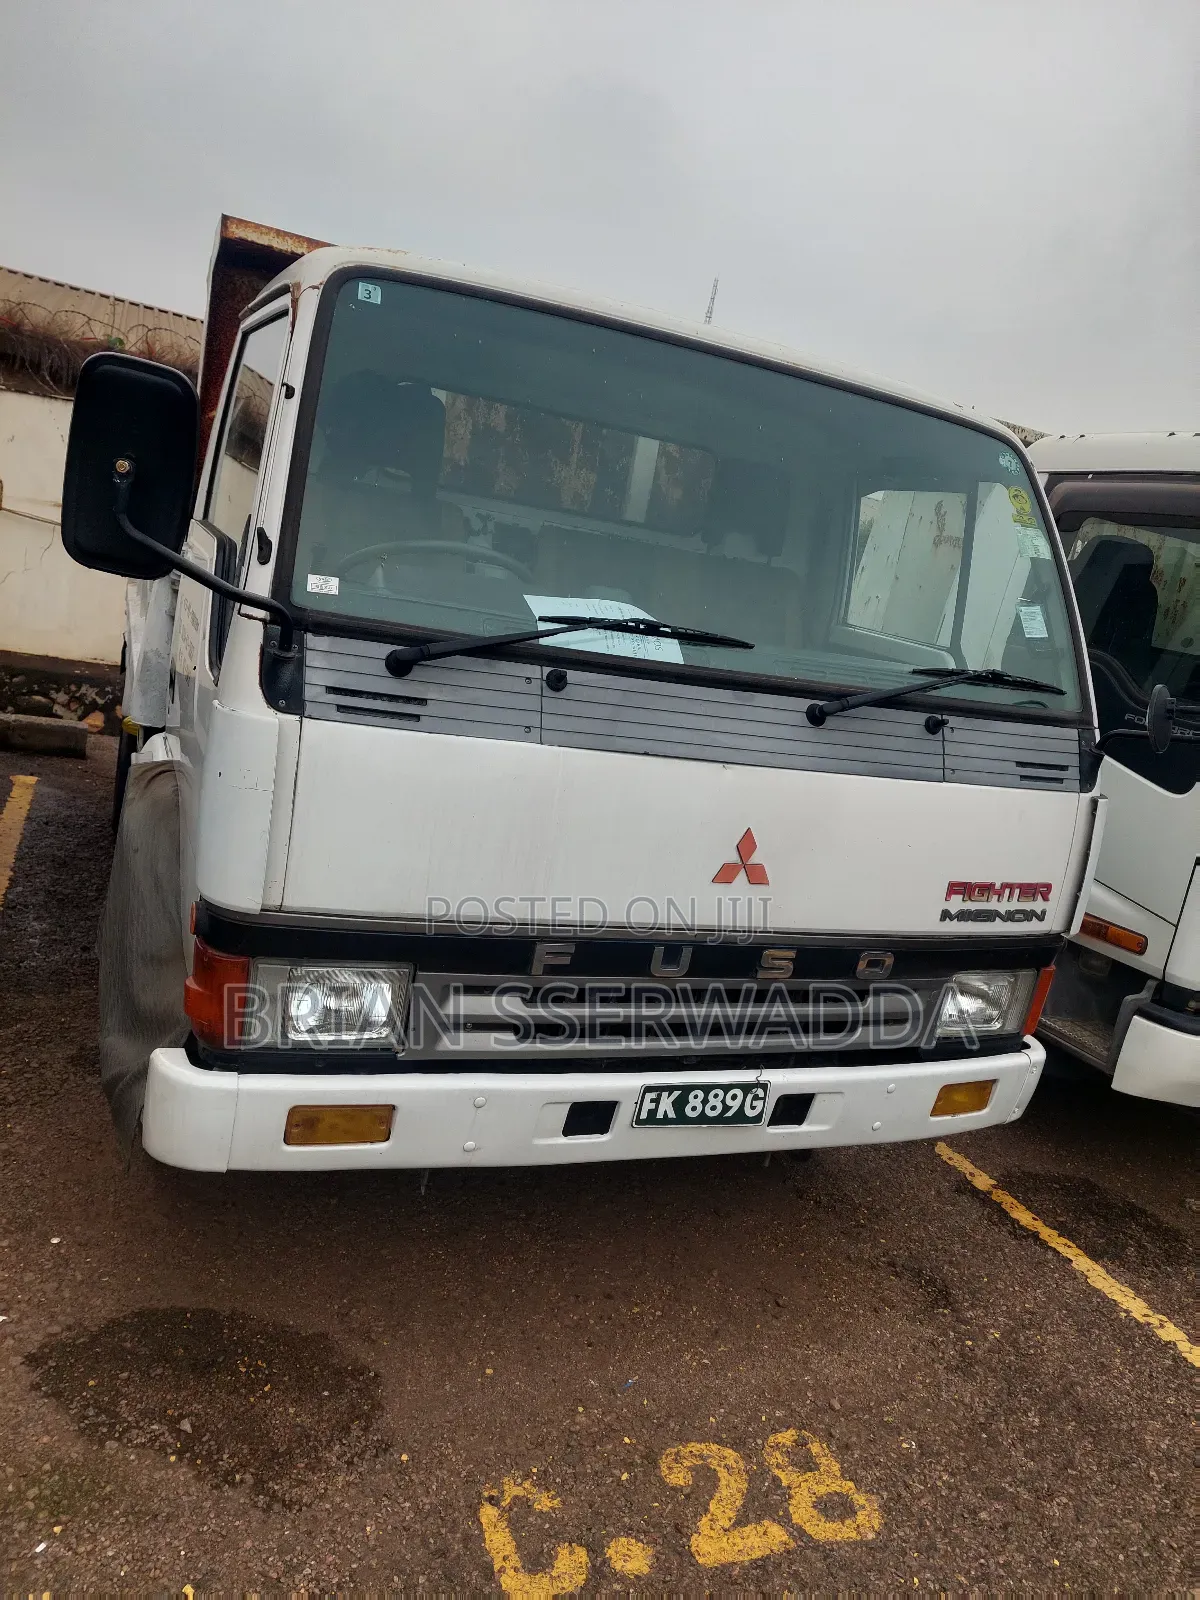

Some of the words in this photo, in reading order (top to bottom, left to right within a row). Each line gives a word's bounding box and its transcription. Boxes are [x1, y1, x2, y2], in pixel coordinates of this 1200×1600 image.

[363, 288, 372, 300] 3
[944, 880, 1053, 902] FIGHTER
[939, 908, 1047, 922] MIGNON
[529, 942, 895, 979] FUSO
[639, 1090, 682, 1120] FK
[684, 1088, 765, 1118] 889G
